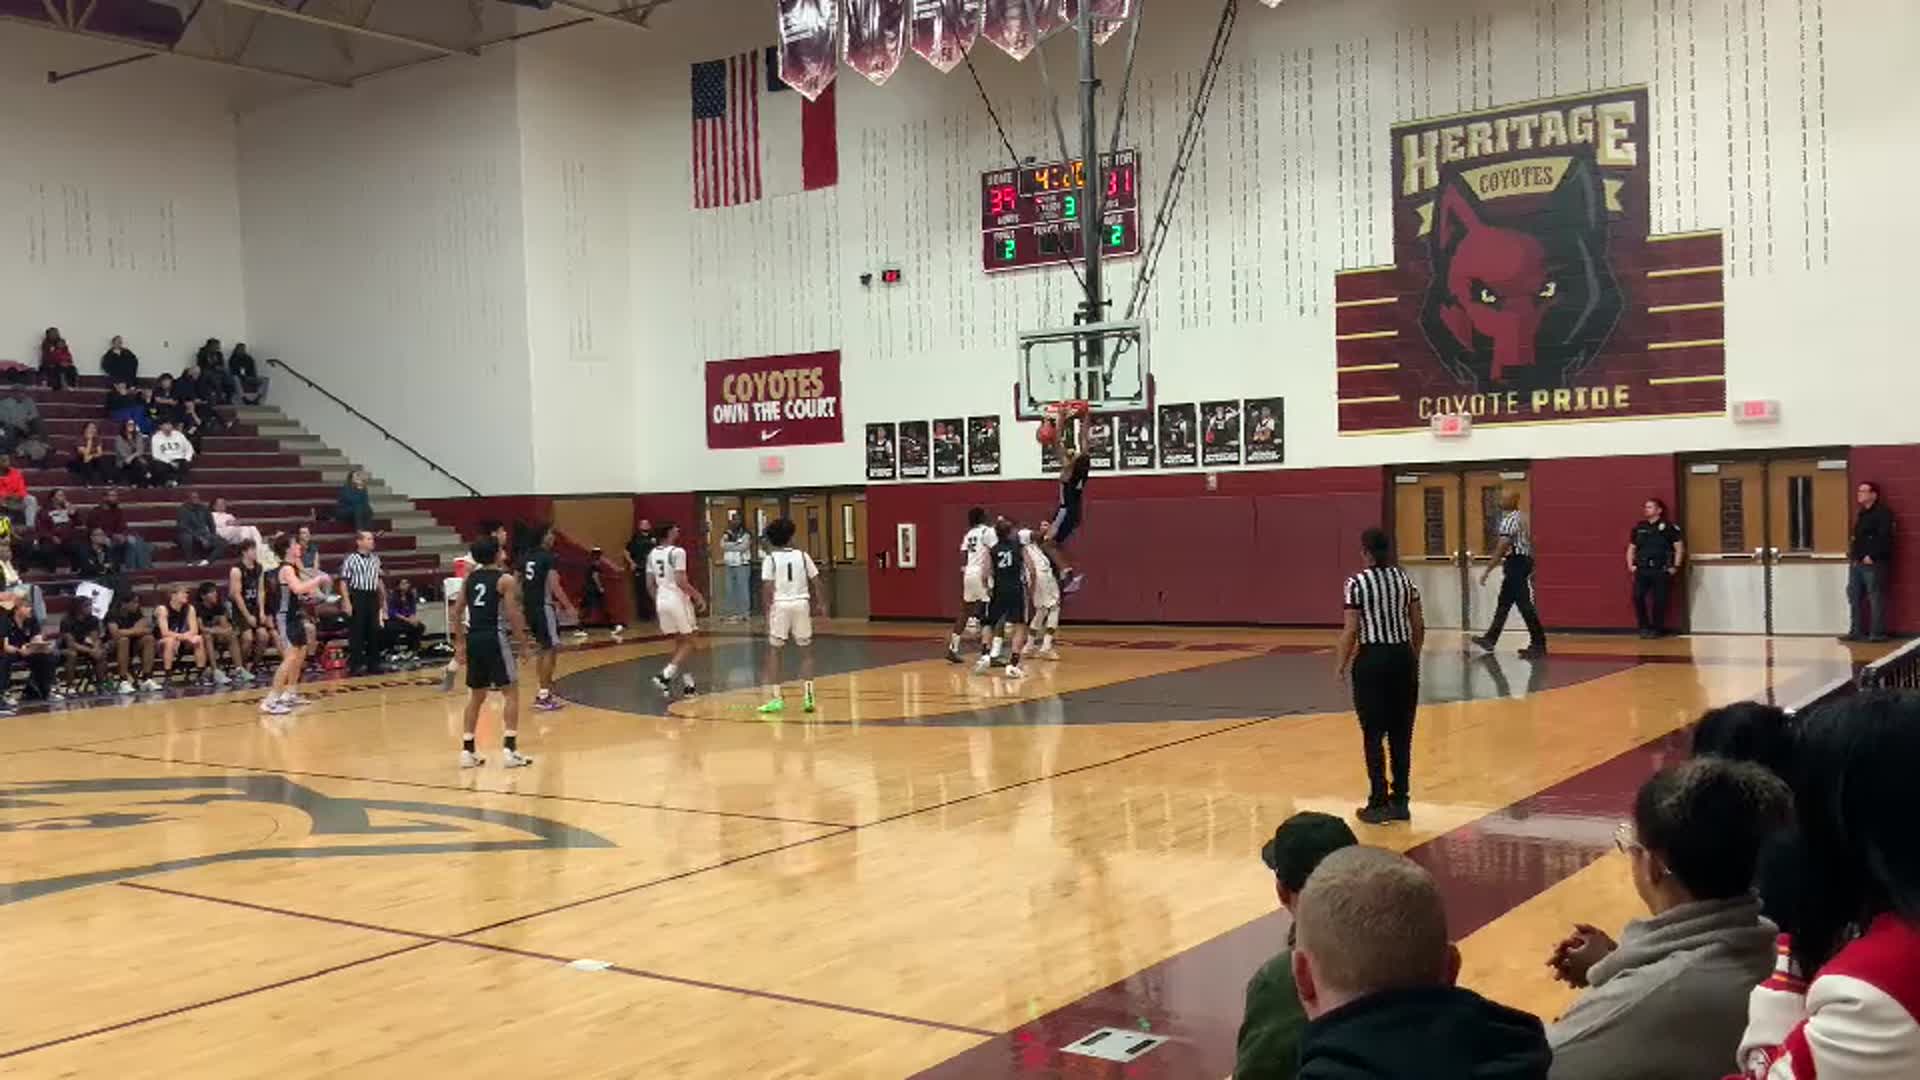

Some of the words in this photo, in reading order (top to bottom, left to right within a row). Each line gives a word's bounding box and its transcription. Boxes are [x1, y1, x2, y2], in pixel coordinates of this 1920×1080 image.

[1402, 100, 1637, 196] HERITAGE
[1478, 164, 1554, 193] COYOTES
[991, 187, 1016, 214] 39
[1063, 195, 1076, 217] 3
[1111, 225, 1123, 246] 2
[1004, 240, 1016, 260] 2
[724, 367, 824, 402] COYOTES
[713, 403, 749, 424] OWN
[752, 401, 781, 422] THE
[784, 397, 836, 420] COURT
[1418, 390, 1519, 420] COYOTE
[1531, 385, 1630, 413] PRIDE
[526, 560, 536, 581] 5
[786, 563, 794, 582] 1
[474, 583, 487, 607] 2
